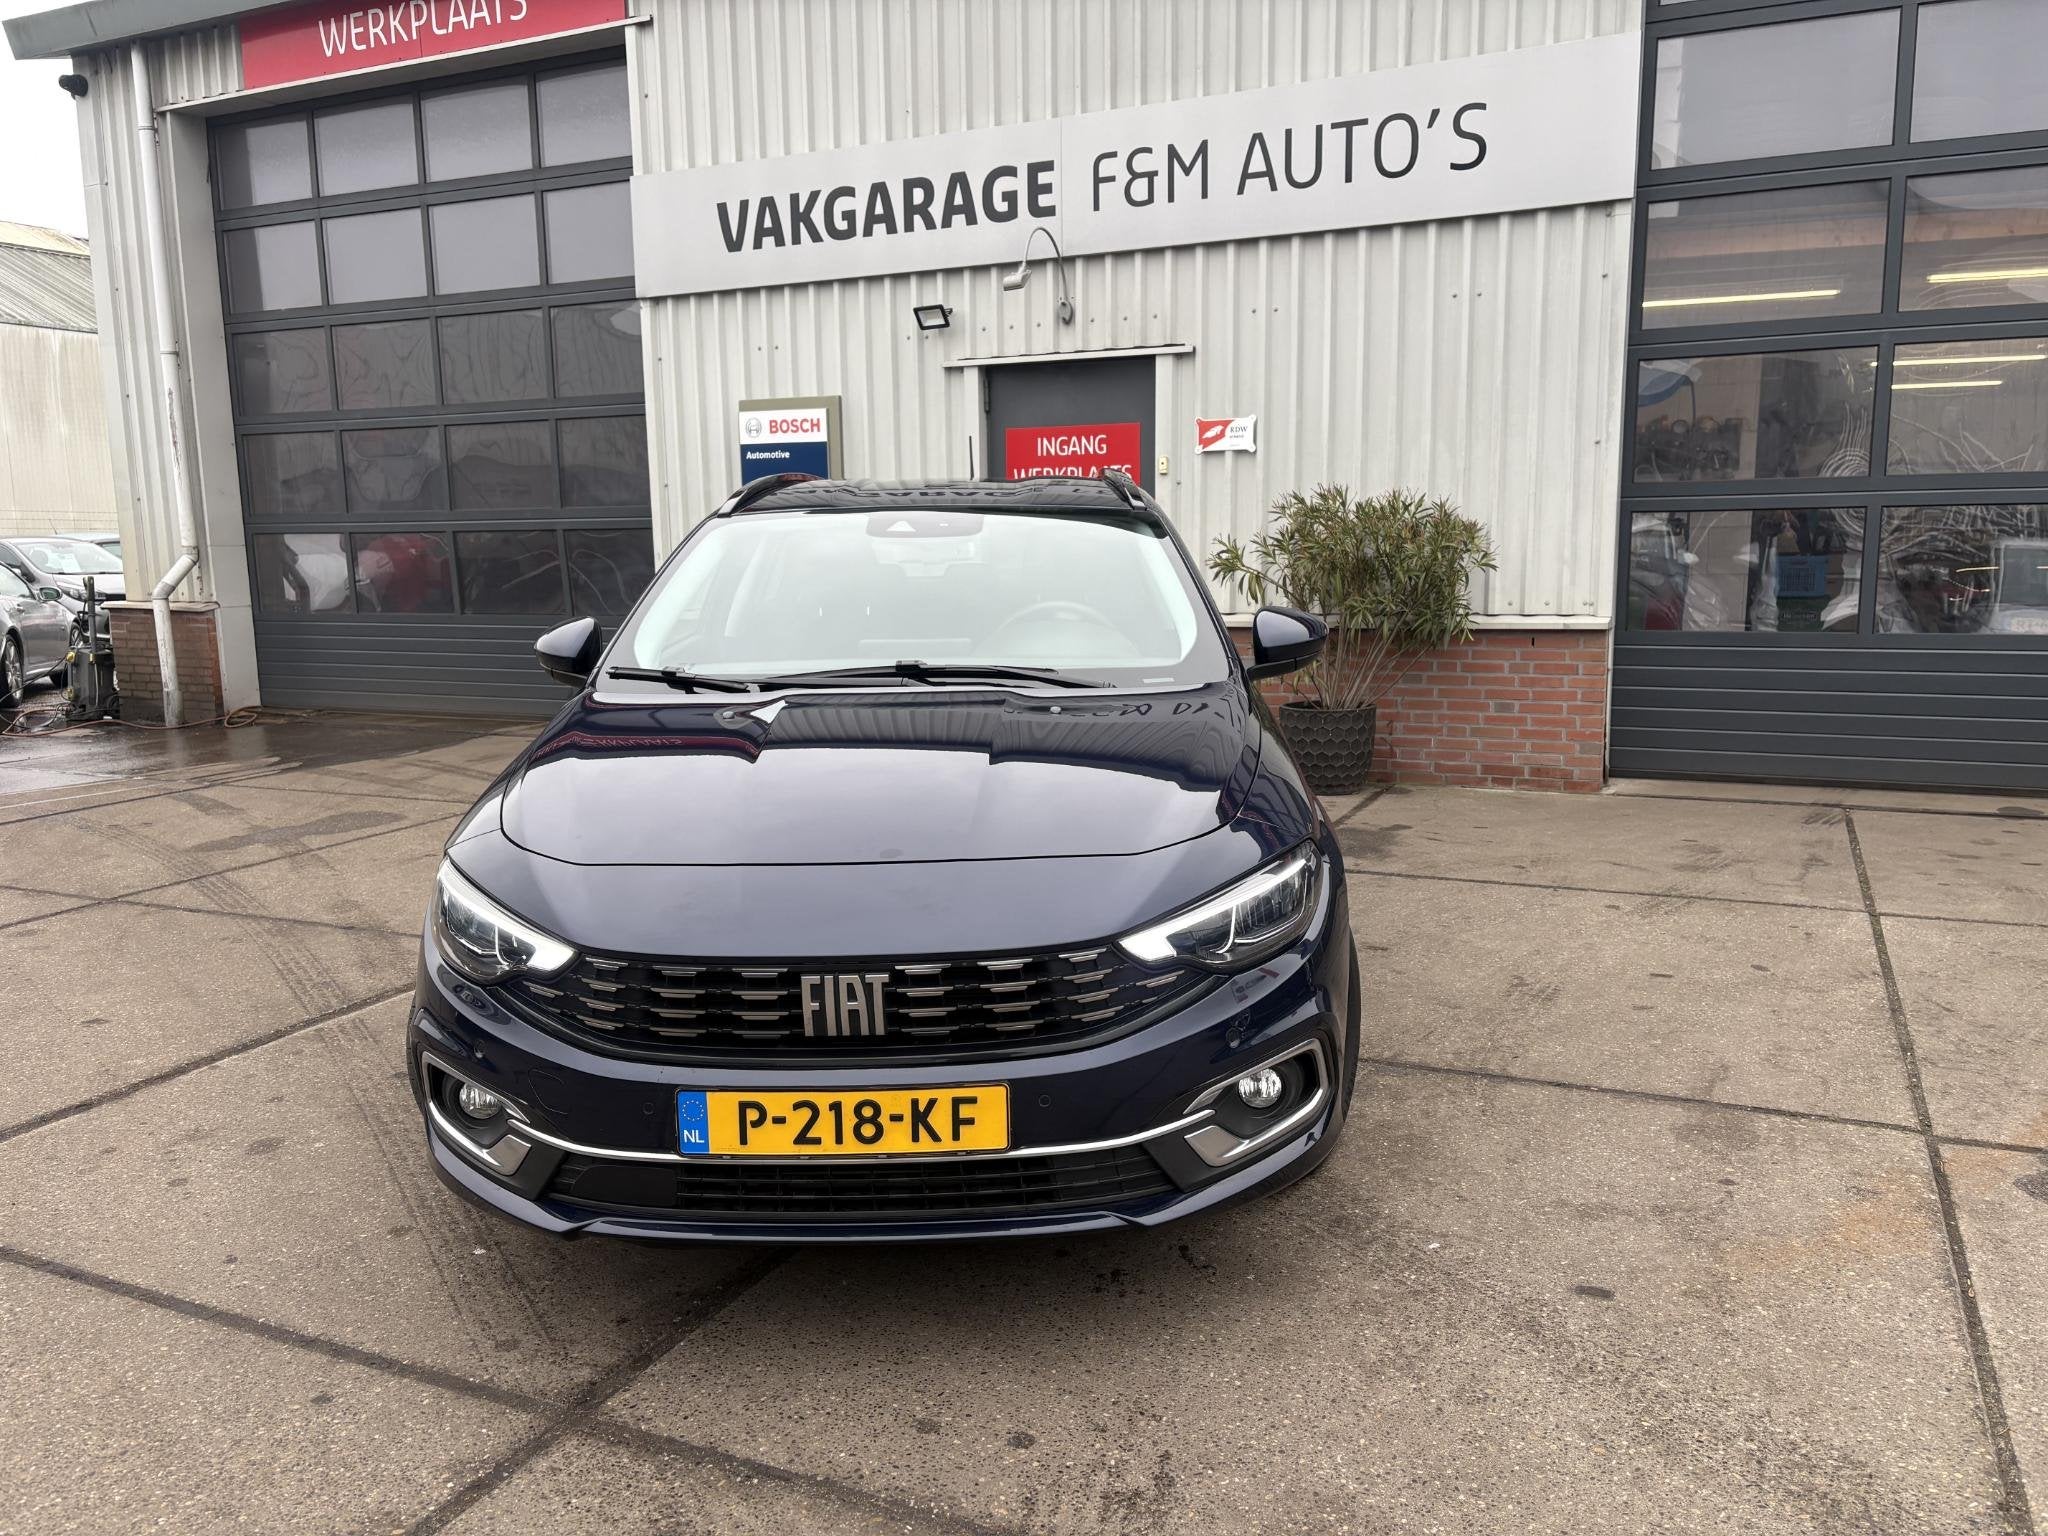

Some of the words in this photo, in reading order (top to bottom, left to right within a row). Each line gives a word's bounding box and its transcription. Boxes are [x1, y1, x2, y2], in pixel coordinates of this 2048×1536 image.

[319, 0, 528, 57] WERKPLAATS
[716, 159, 1057, 253] VAKGARAGE
[1092, 138, 1209, 212] F&M
[1236, 102, 1488, 196] AUTO'S
[769, 418, 821, 434] BOSCH
[1229, 425, 1249, 433] RDW
[746, 449, 790, 460] Automotive
[1037, 434, 1108, 457] INGANG
[800, 974, 890, 1037] FIAT
[737, 1095, 979, 1146] P-218-KF
[683, 1129, 705, 1144] NL
